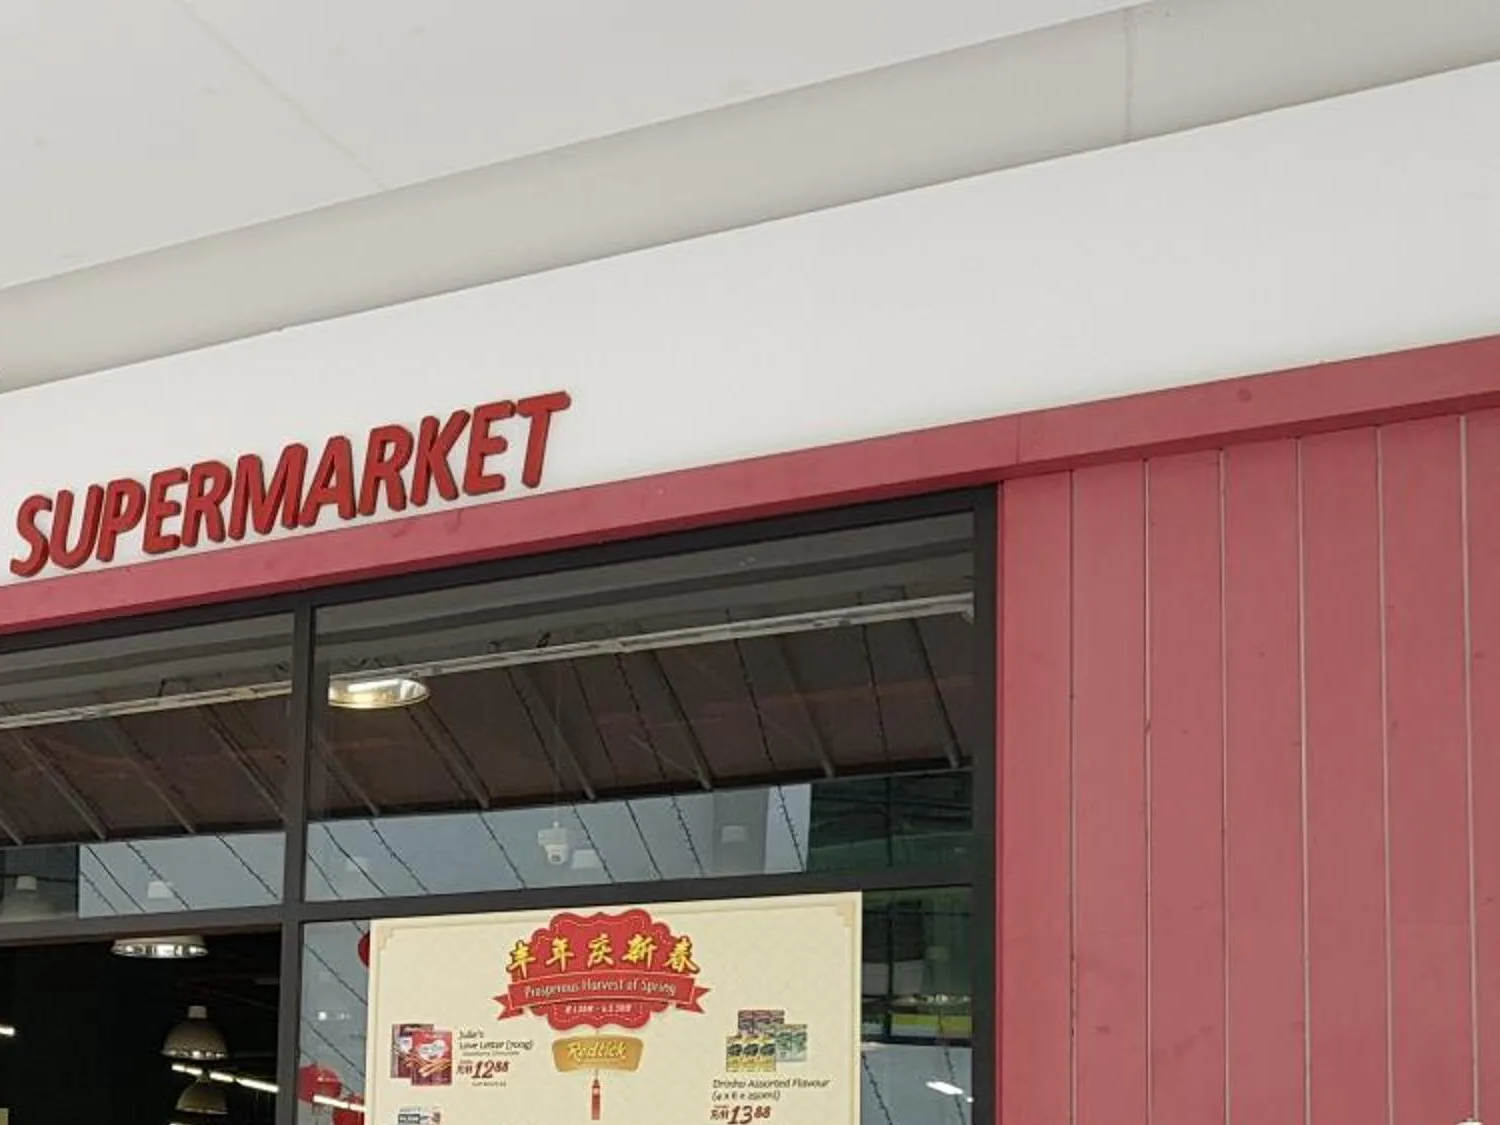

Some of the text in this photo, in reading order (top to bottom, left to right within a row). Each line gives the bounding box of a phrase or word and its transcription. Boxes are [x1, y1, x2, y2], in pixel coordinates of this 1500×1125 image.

[10, 391, 572, 577] SUPERMARKET
[582, 976, 624, 991] Harvest
[627, 977, 638, 990] of
[641, 978, 677, 997] Spring
[748, 1079, 790, 1089] Assorted
[792, 1079, 831, 1088] Flavour
